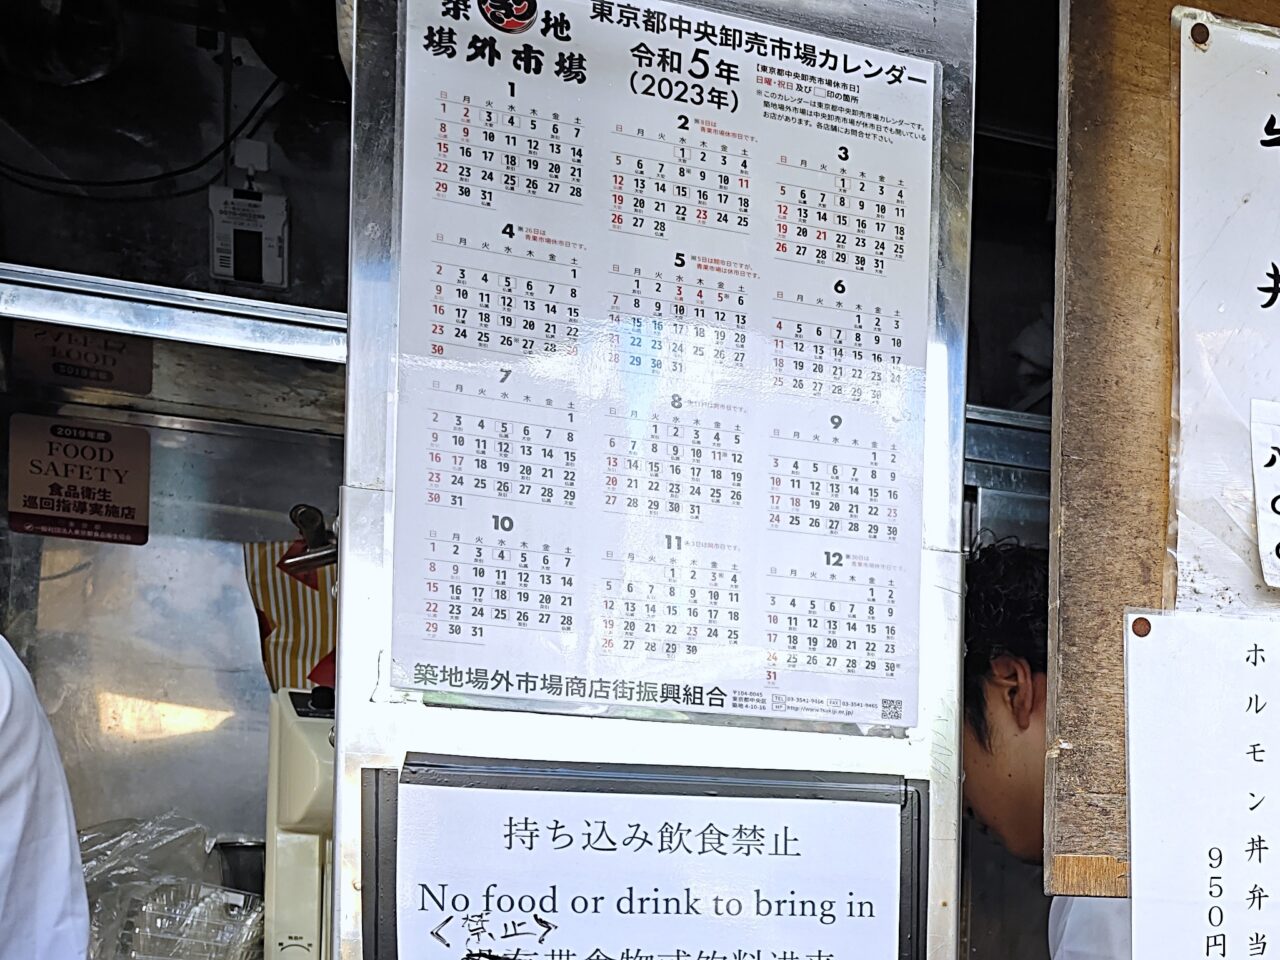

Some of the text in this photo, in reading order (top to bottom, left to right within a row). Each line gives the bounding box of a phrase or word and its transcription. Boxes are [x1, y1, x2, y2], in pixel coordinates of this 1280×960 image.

[589, 0, 927, 86] 東京都中央卸売市場カレンダー
[423, 26, 587, 84] 場外市場
[630, 42, 740, 86] 令和5年
[508, 82, 516, 97] 1
[629, 70, 739, 113] (2023年)
[441, 103, 580, 138] 1 2 3 4 5 6 7
[677, 115, 690, 131] 2
[440, 123, 583, 158] 8 9 10 11 12 13 14
[437, 142, 581, 178] 15 16 17 18 19 20 21
[837, 146, 849, 161] 3
[436, 162, 582, 197] 22 23 24 25 26 27 28
[435, 181, 492, 201] 29 30 31
[501, 223, 516, 239] 4
[674, 253, 686, 268] 5
[833, 279, 846, 294] 6
[499, 368, 512, 384] 7
[670, 393, 683, 409] 8
[830, 415, 842, 429] 9
[46, 441, 114, 463] FOOD
[29, 459, 129, 485] SAFETY
[48, 482, 112, 502] 食品衛生
[22, 494, 136, 520] 巡回指導実施店
[492, 515, 514, 532] 10
[665, 535, 682, 550] 11
[824, 551, 843, 567] 12
[429, 562, 506, 580] 8 9 10 11
[770, 596, 893, 617] 3 4 5 6 7 8 9
[414, 662, 728, 708] 築地場外市場商店街振興組合
[1244, 642, 1270, 958] ホルモン丼弁当
[503, 816, 802, 858] 持ち込み飲食禁止
[417, 884, 876, 925] No food or drink to bring in
[1204, 846, 1227, 959] 950円
